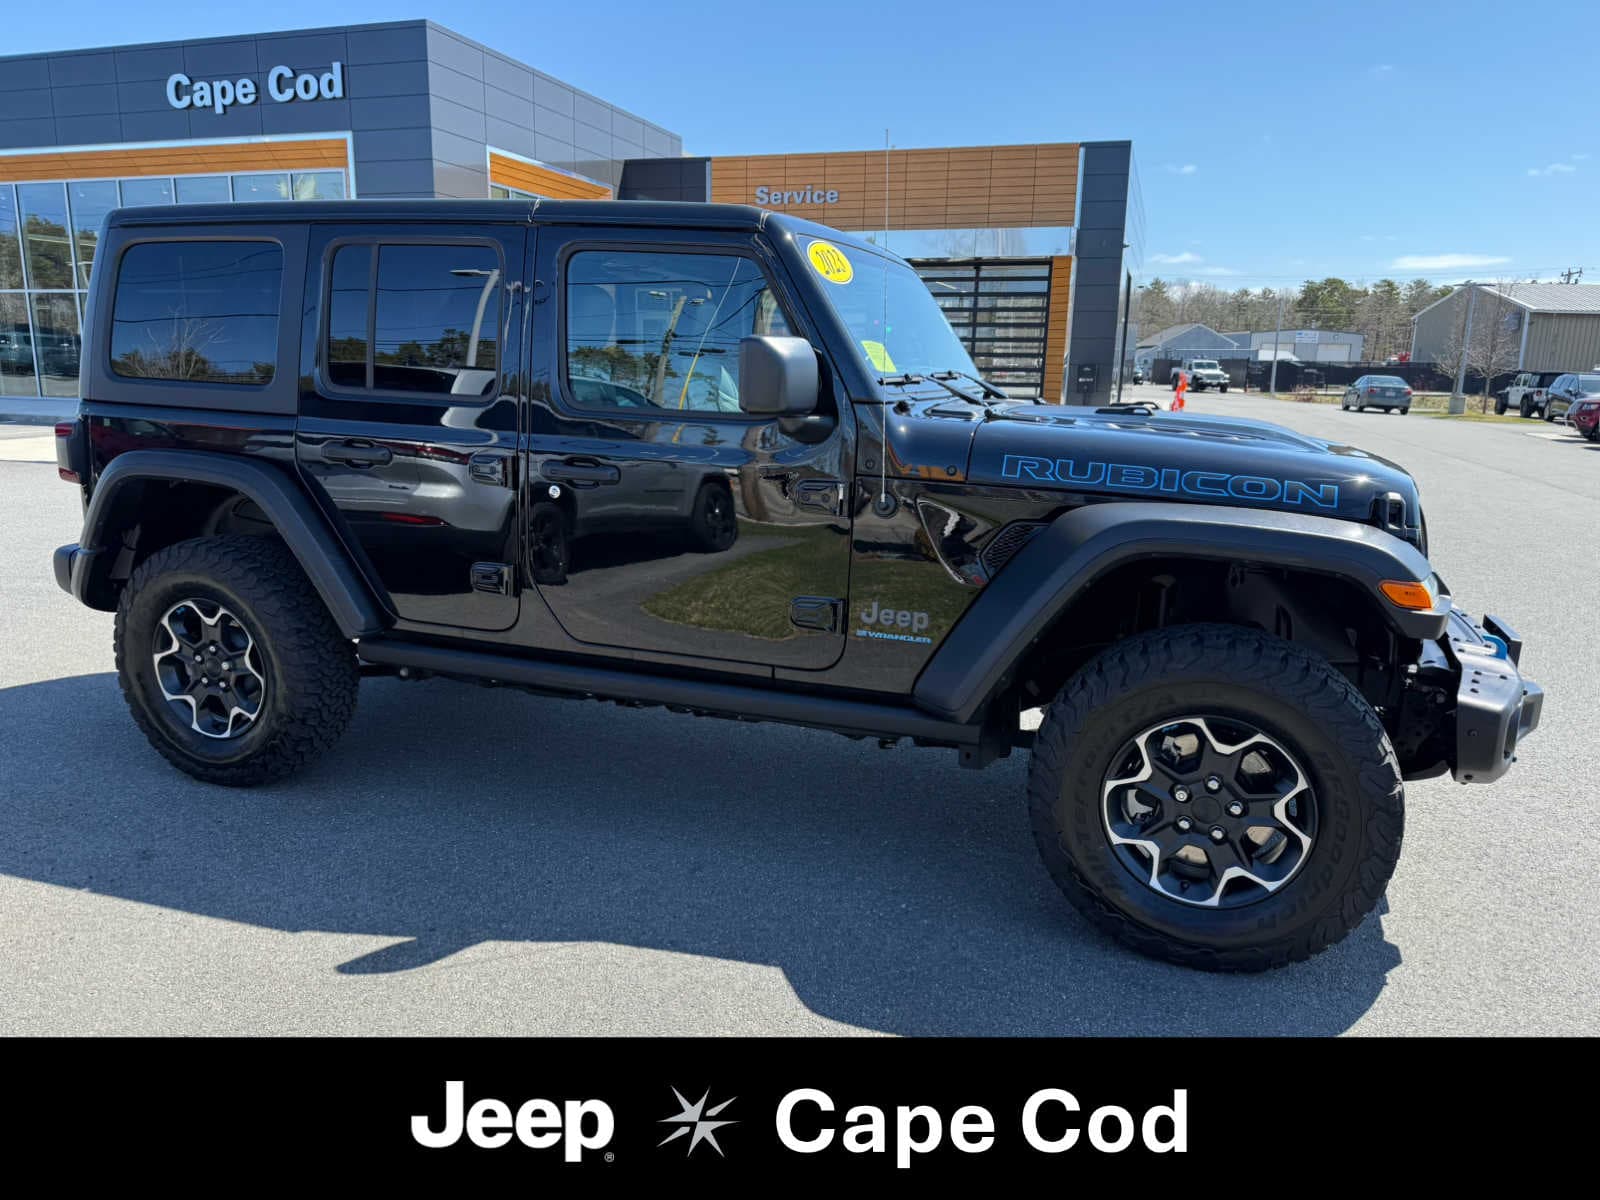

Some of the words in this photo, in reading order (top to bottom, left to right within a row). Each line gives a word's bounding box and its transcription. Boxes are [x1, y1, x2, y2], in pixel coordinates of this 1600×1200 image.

[166, 73, 257, 114] Cape
[268, 61, 344, 102] Cod
[755, 184, 839, 206] Service
[816, 249, 847, 274] 2023
[1002, 454, 1338, 508] RUBICON
[860, 601, 929, 633] Jeep
